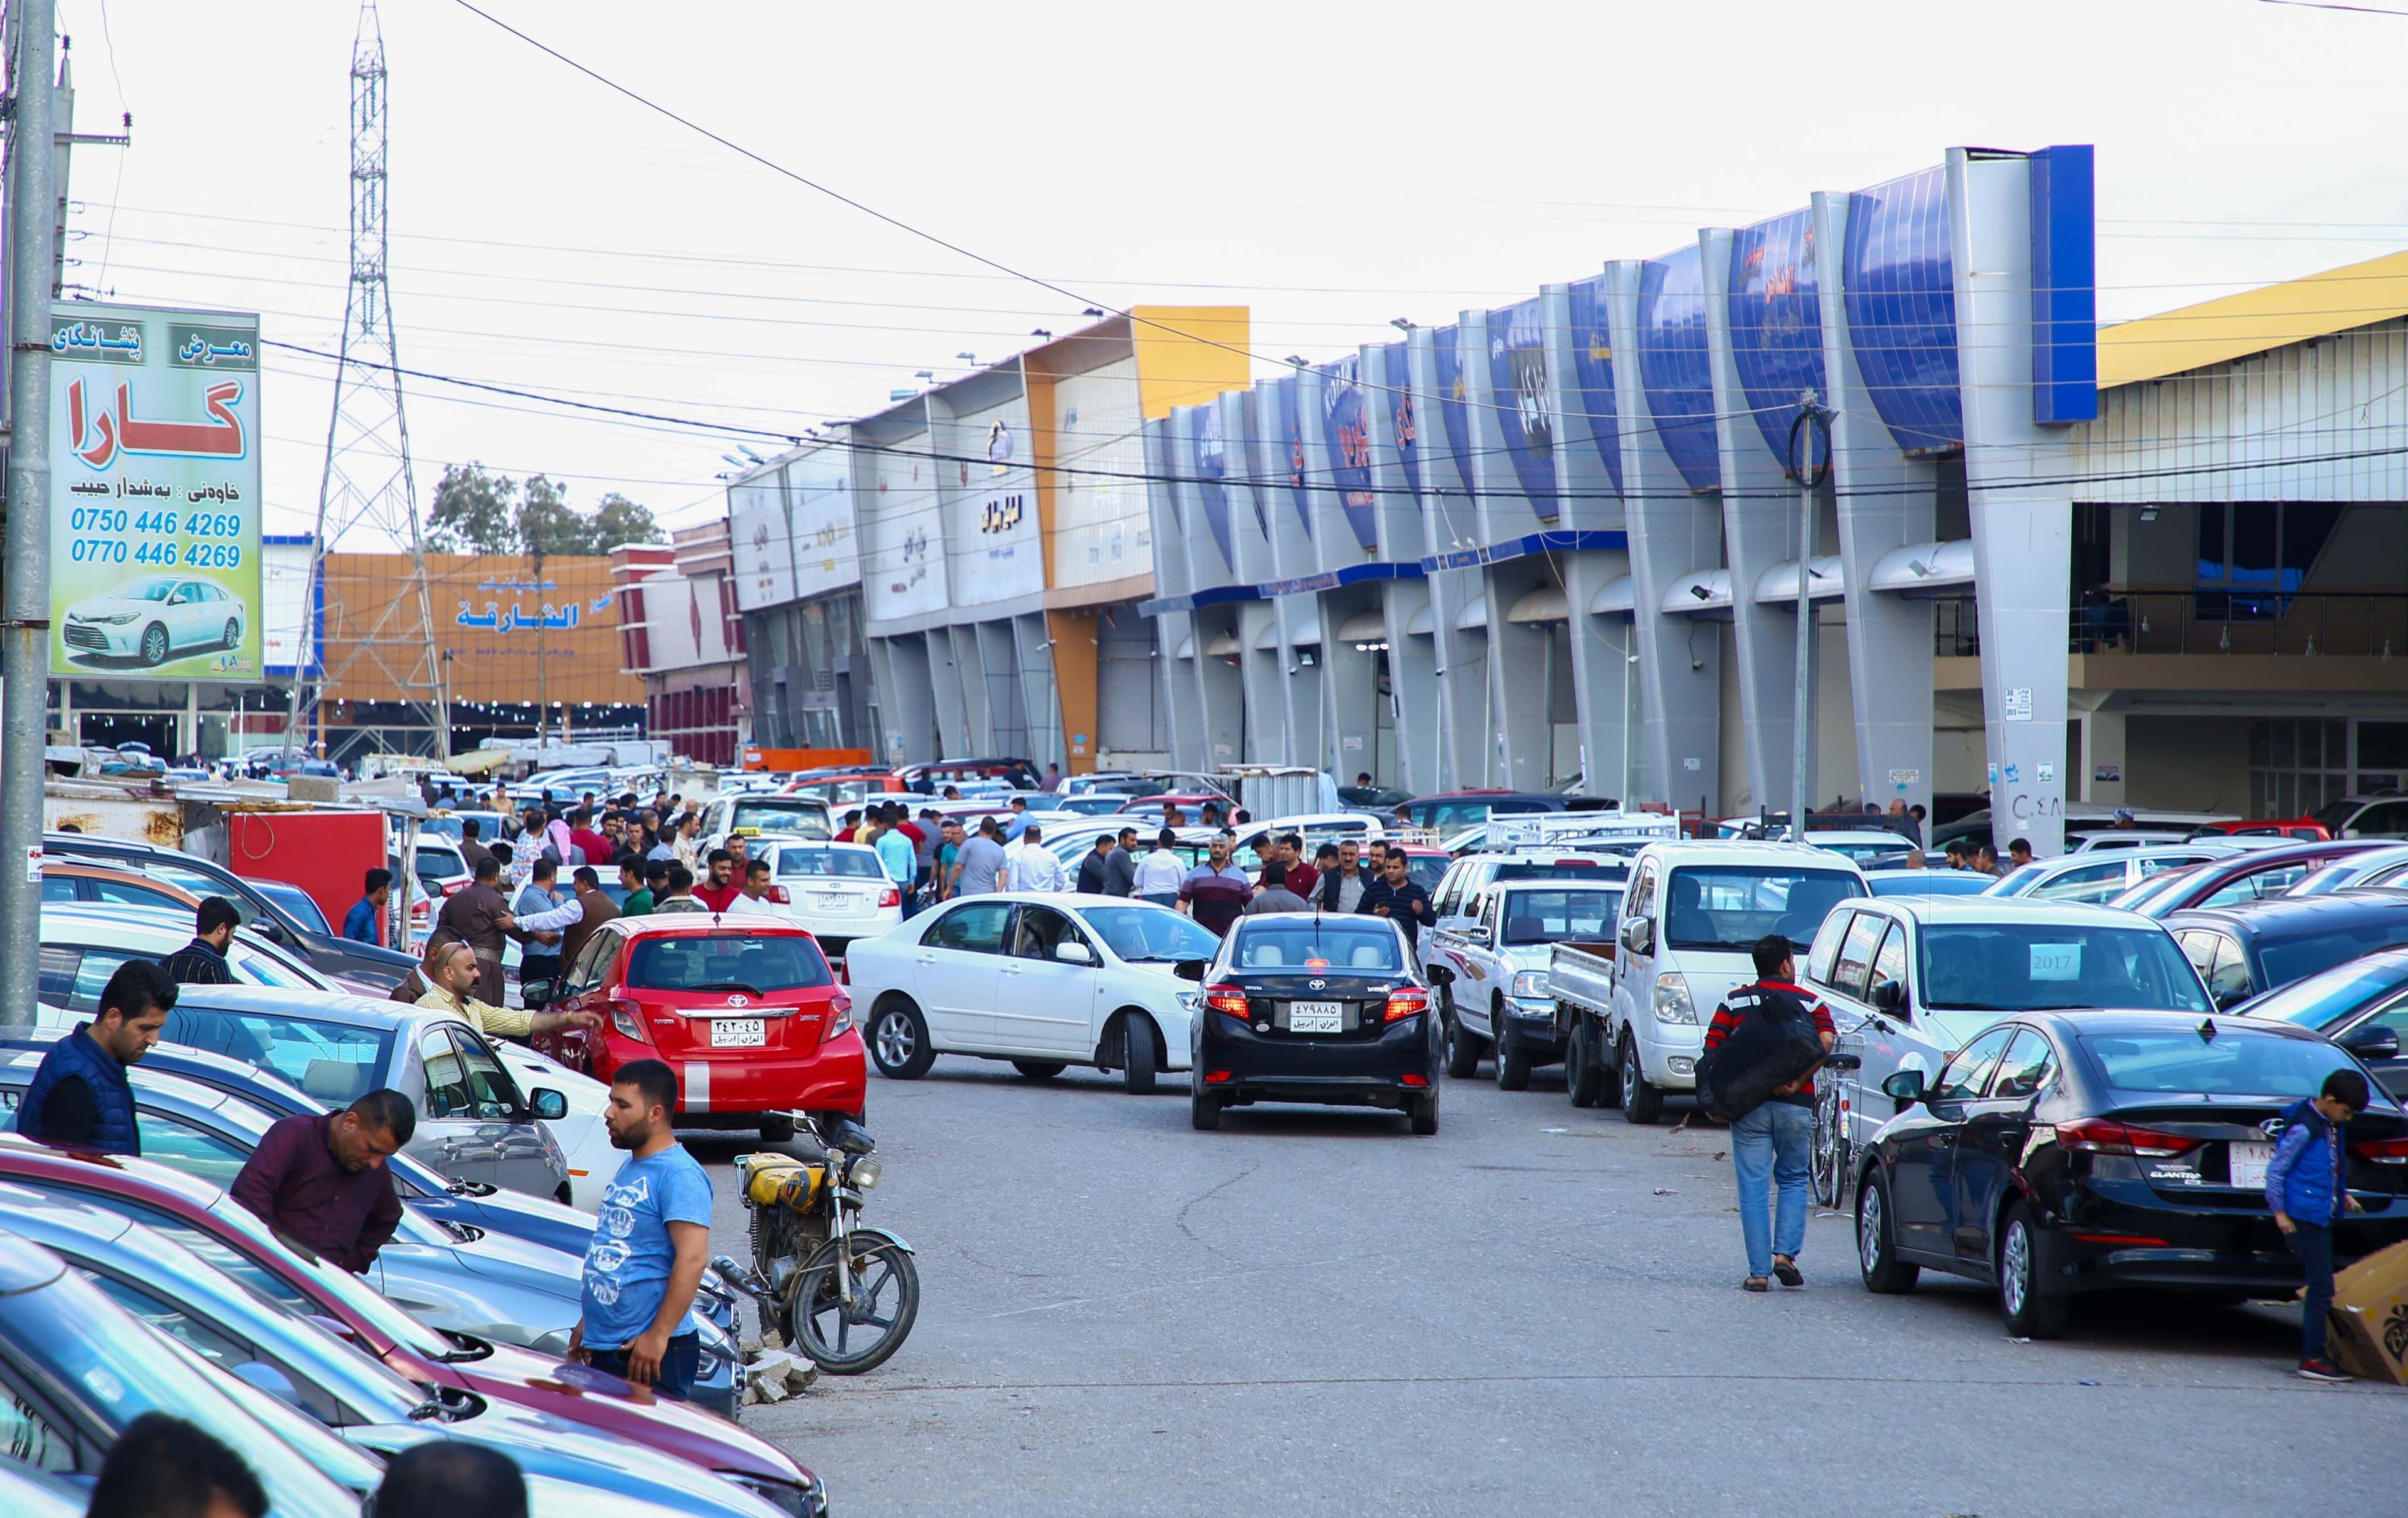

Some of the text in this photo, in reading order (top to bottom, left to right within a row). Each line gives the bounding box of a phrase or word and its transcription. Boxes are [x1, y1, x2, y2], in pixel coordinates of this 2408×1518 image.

[179, 334, 251, 362] معرض
[68, 378, 243, 469] گارا
[70, 507, 241, 537] 0750 446 4269
[71, 538, 241, 568] 0770 446 4269
[456, 602, 580, 634] الشارقة
[2033, 955, 2071, 970] 2017
[2150, 1170, 2202, 1179] ELANTRA
